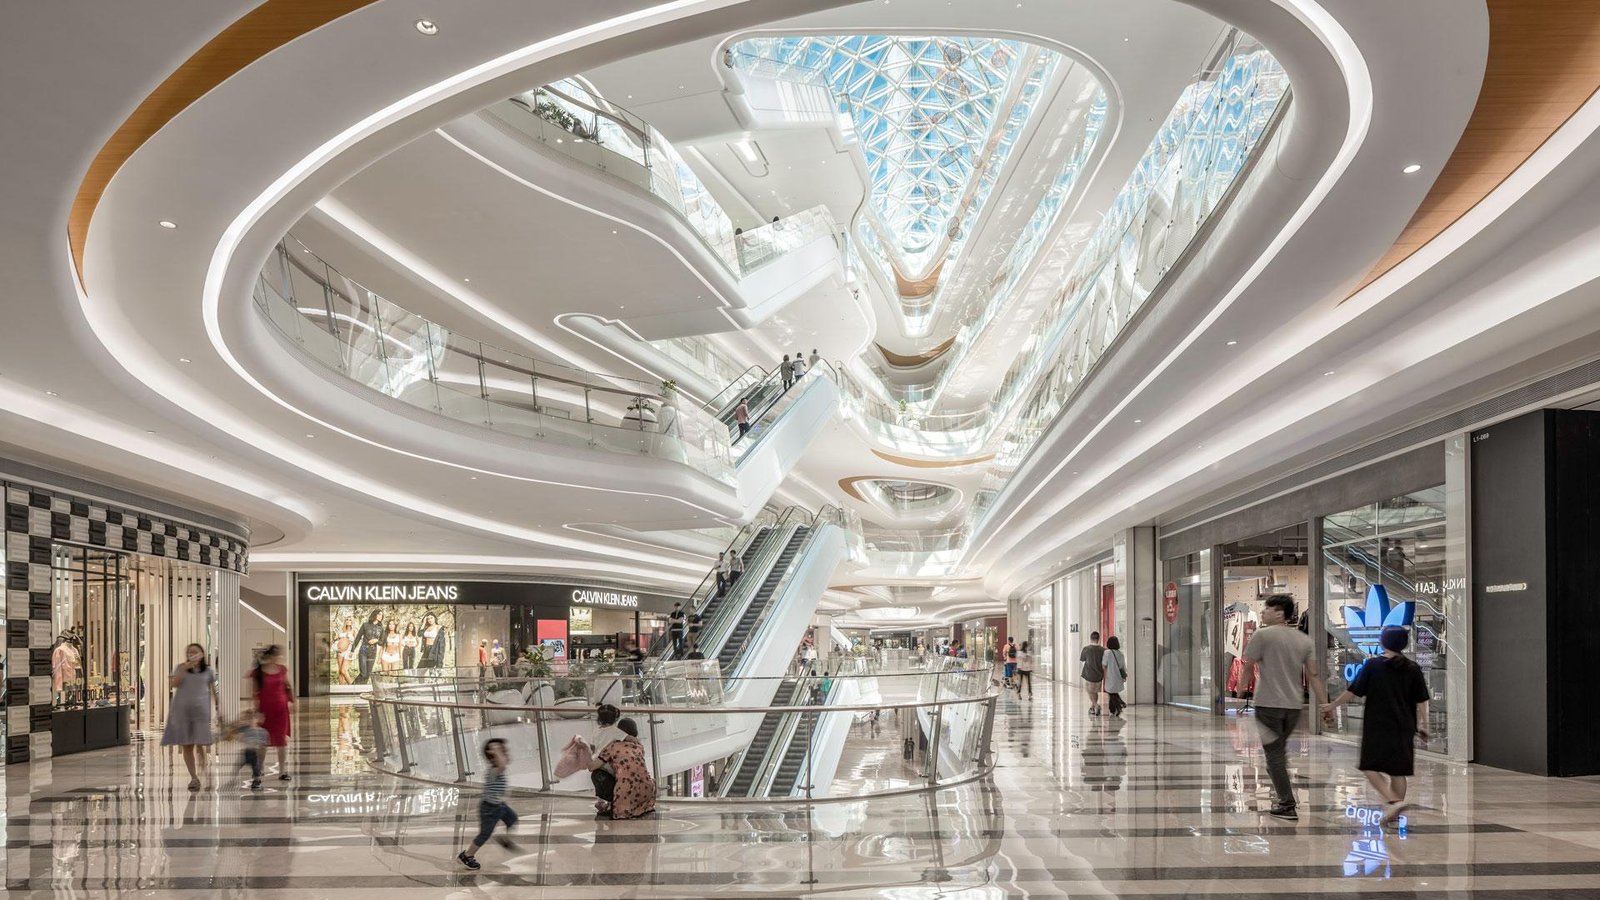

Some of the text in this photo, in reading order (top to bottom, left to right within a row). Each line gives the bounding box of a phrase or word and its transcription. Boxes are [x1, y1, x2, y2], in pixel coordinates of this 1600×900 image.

[307, 586, 458, 601] CALVIN KLEIN JEANS
[572, 590, 638, 607] CALVIN KLEIN JEANS
